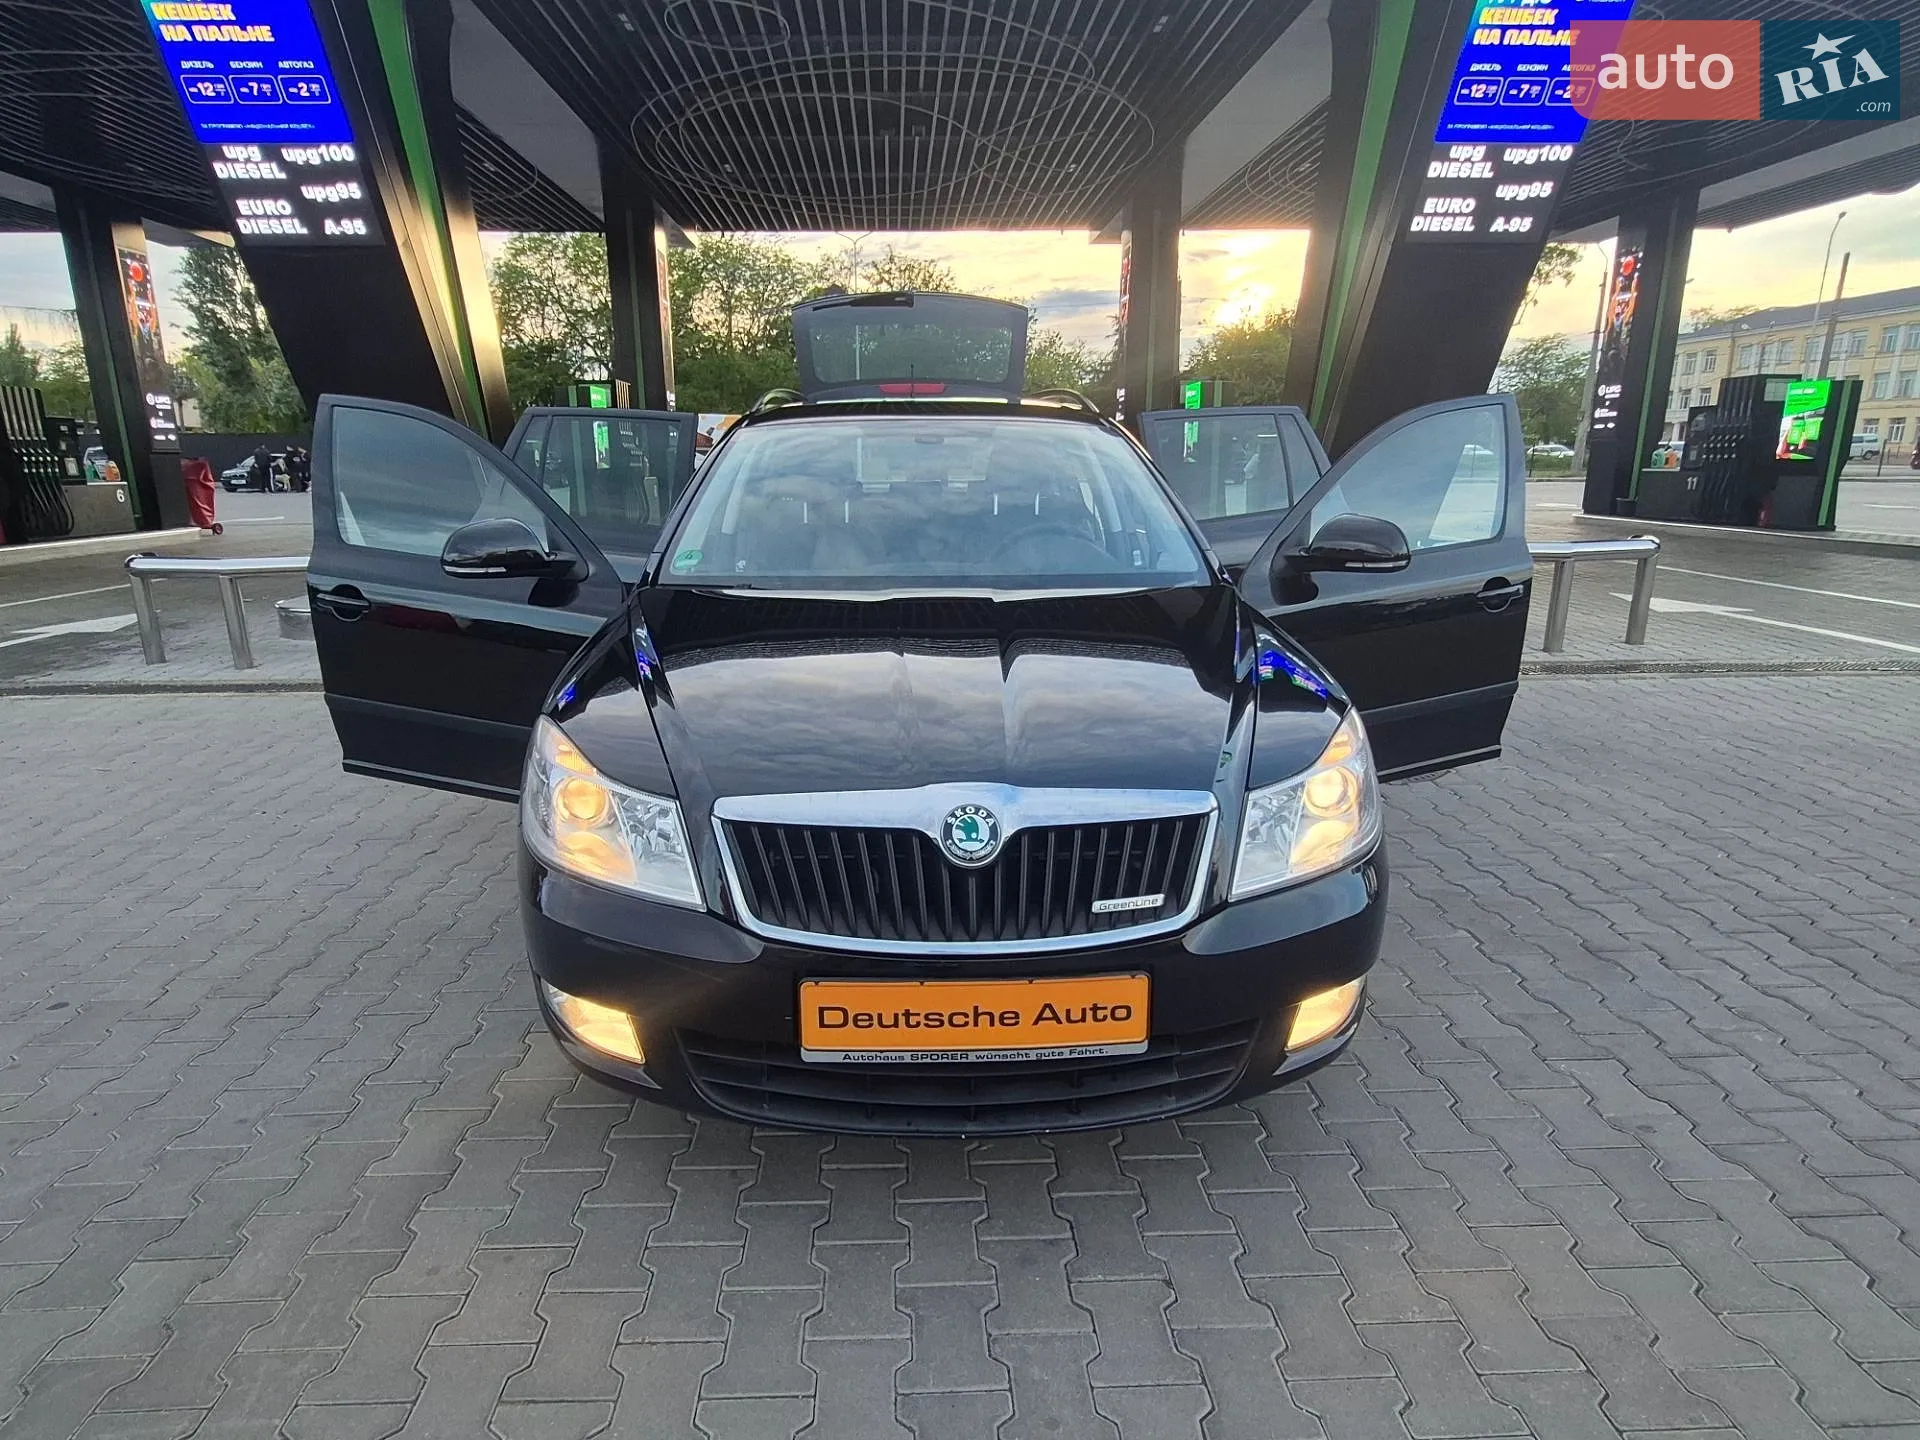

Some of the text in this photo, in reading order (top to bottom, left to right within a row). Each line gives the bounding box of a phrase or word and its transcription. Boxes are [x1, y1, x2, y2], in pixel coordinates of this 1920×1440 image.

[151, 2, 236, 21] КЕШБЕК
[1479, 8, 1559, 25] КЕШБЕК
[160, 25, 275, 42] НА ПАЛЬНЕ
[1473, 29, 1580, 46] НА ПАЛЬНЕ
[181, 60, 314, 69] ДИЗЕЛЬ БЕНЗИН АВТОГАЗ
[1470, 63, 1502, 72] ДИЗЕЛЬ
[1517, 64, 1549, 72] БЕНЗИН
[223, 146, 355, 164] upg upg100
[1449, 146, 1573, 165] upg upg100
[212, 162, 287, 180] DIESEL
[1427, 163, 1494, 178] DIESEL
[301, 183, 362, 203] upg95
[1495, 182, 1554, 201] upg95
[235, 199, 292, 216] EURO
[1423, 198, 1476, 213] EURO
[236, 218, 367, 235] DIESEL A-95
[1410, 216, 1533, 232] DIESEL A-95
[1687, 476, 1699, 490] 11
[117, 489, 125, 503] 6
[818, 1002, 1132, 1029] Deutsche Auto
[842, 1052, 905, 1062] Autohaus
[975, 1050, 1030, 1060] wünscht
[1036, 1050, 1064, 1060] gute
